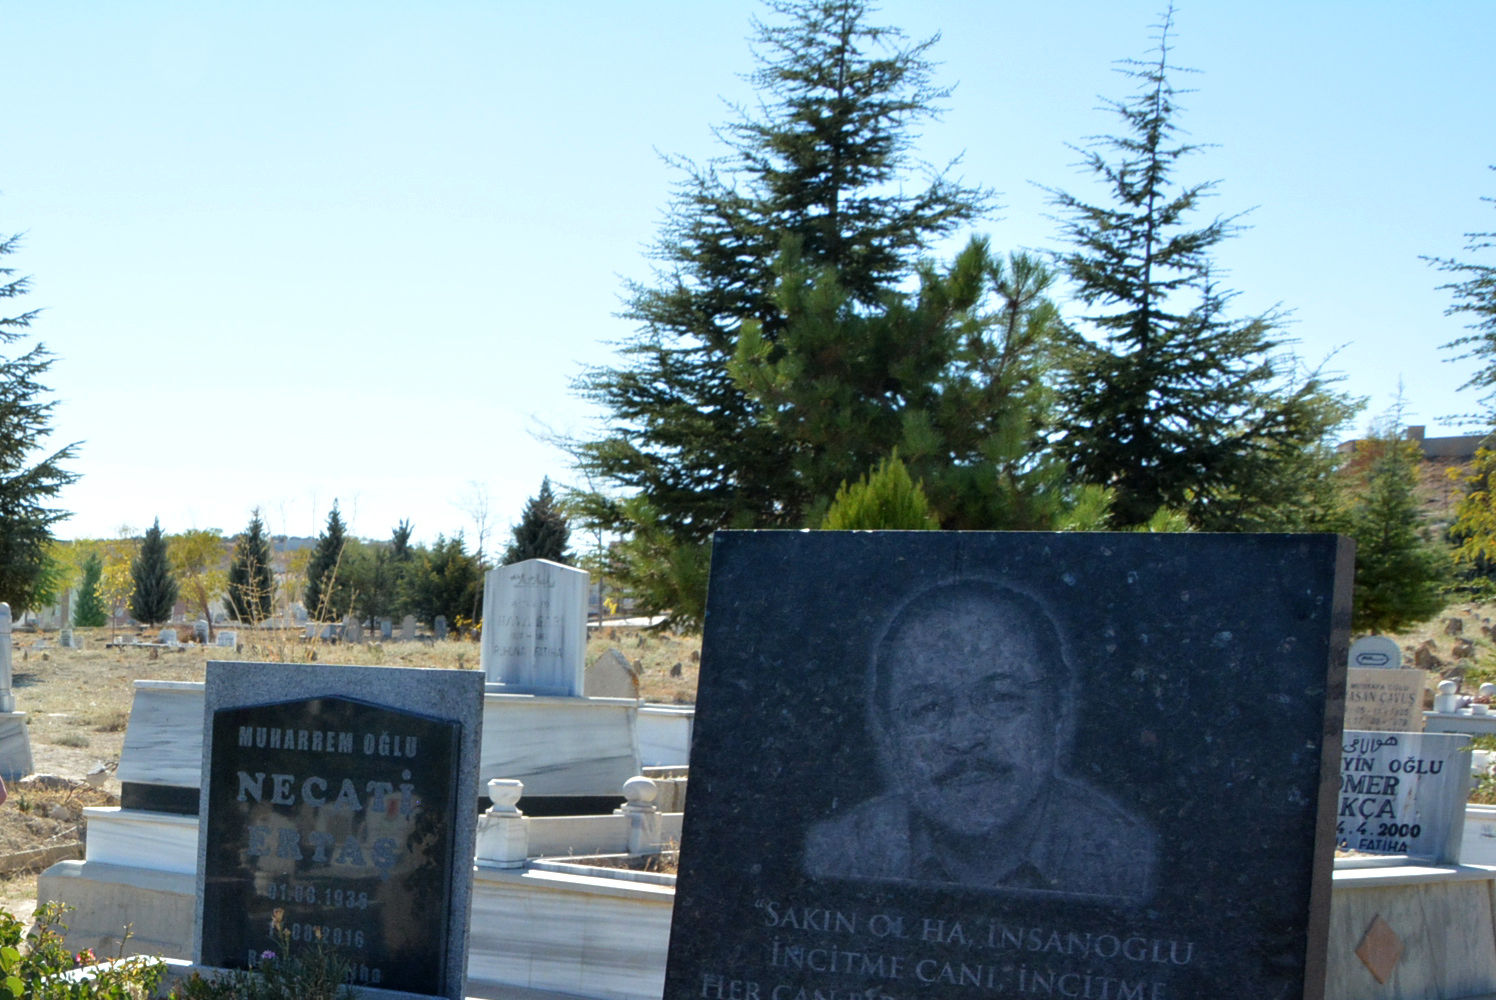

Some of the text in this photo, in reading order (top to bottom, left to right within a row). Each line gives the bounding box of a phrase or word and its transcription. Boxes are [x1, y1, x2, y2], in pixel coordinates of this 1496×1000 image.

[1348, 691, 1376, 703] ASAN
[238, 725, 419, 759] MUHARREM OĞLU
[1342, 755, 1444, 774] YİN OĞLU
[236, 768, 417, 822] NECATİ
[1338, 796, 1397, 820] KÇA
[247, 825, 400, 882] ERTAŞ
[1358, 837, 1409, 853] FATİHA
[869, 913, 910, 940] OL
[987, 918, 1195, 966] İNSANOĞLU
[770, 935, 904, 980] İNCİTME
[914, 958, 1004, 992] CANI,
